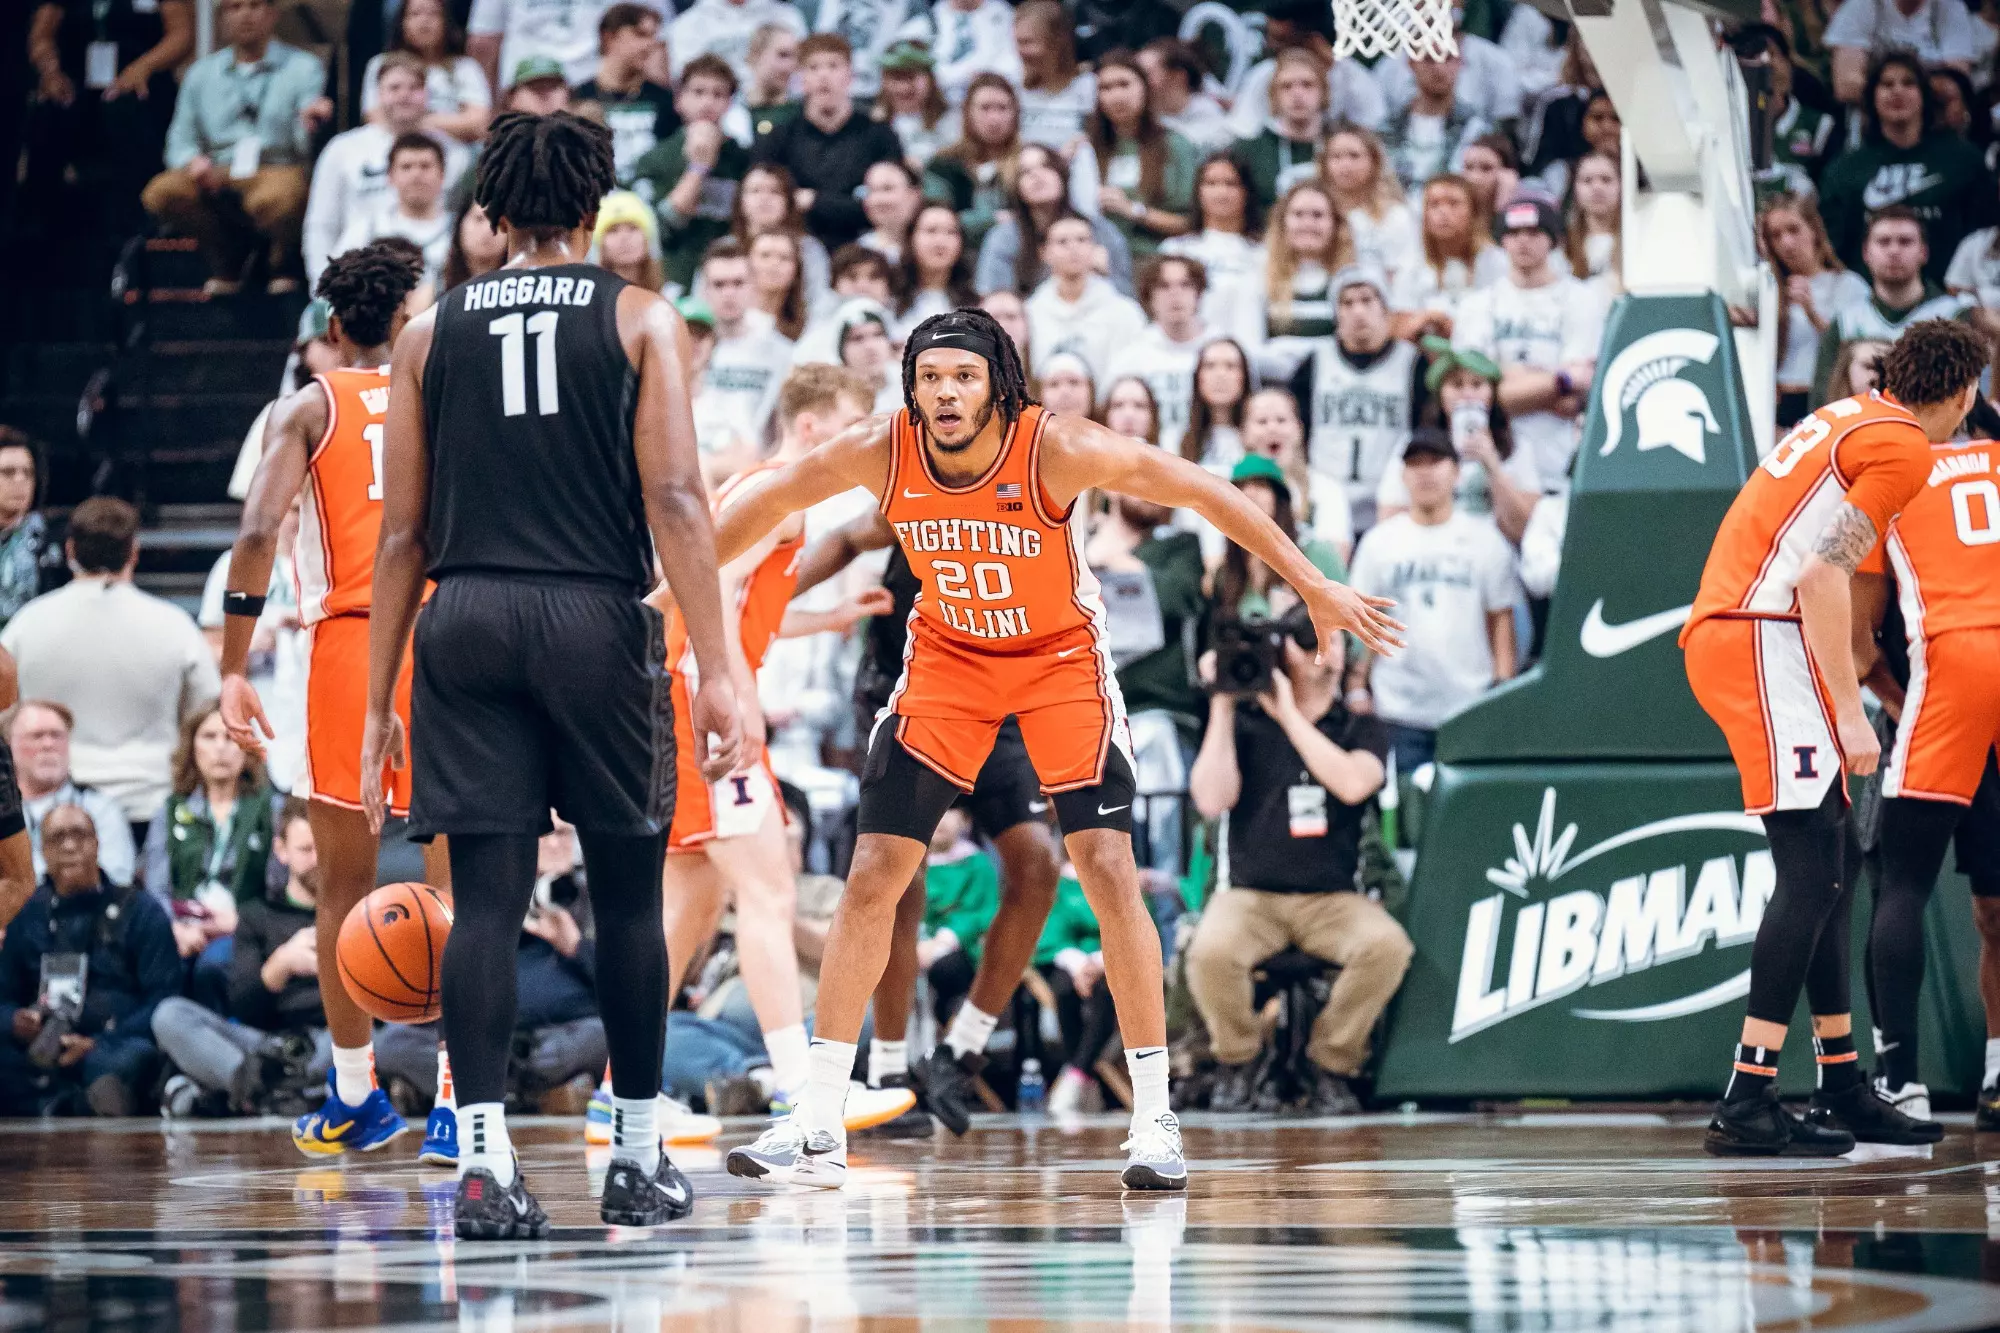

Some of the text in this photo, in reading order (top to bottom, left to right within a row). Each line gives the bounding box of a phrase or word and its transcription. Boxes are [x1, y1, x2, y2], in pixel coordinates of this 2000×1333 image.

[464, 276, 596, 311] HOGGARD
[489, 311, 560, 416] 11
[362, 423, 384, 500] 1
[1950, 479, 2000, 547] 0
[893, 518, 1041, 558] FIGHTING
[930, 559, 1013, 601] 20
[938, 597, 1032, 639] ILLINI
